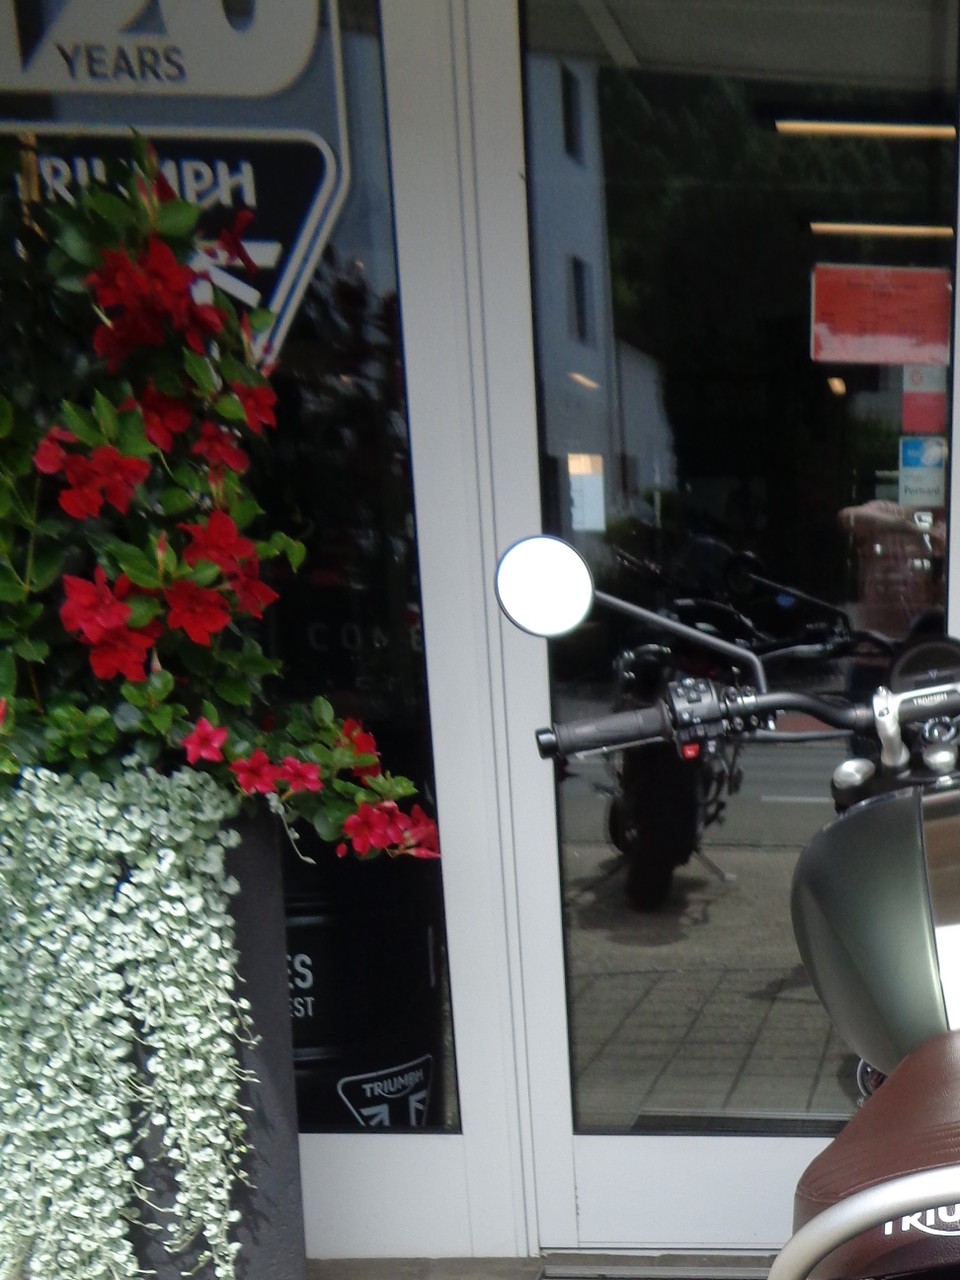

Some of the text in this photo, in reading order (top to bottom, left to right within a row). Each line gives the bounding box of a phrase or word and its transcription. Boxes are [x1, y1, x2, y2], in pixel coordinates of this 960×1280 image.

[56, 43, 188, 82] YEARS
[12, 154, 257, 212] RIPH
[362, 1069, 424, 1098] TRIUMPH
